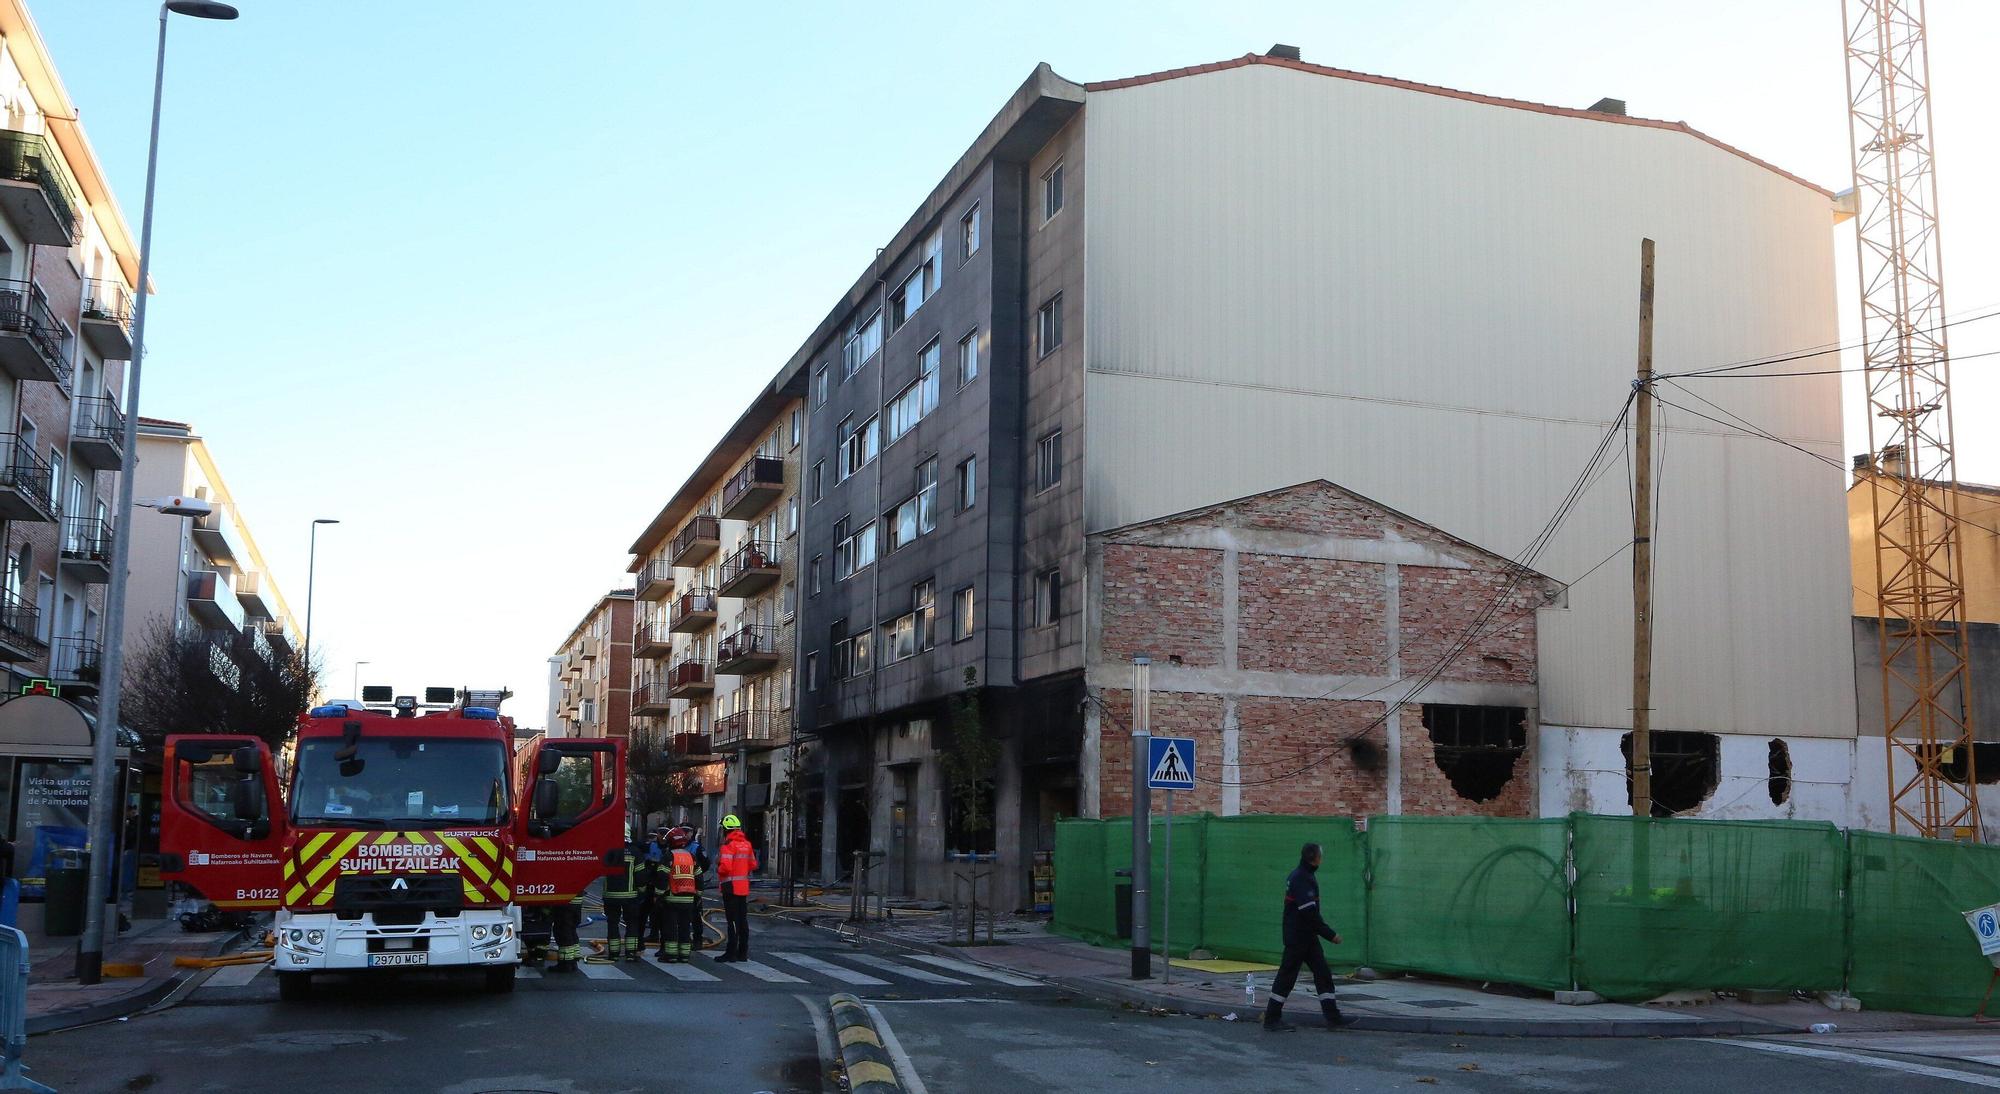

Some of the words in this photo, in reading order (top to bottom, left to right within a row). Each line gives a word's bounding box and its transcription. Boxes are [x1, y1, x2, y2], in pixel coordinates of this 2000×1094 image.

[28, 777, 55, 786] Visita
[72, 778, 91, 786] troc
[28, 787, 40, 796] de
[42, 787, 72, 796] Suecia
[74, 788, 88, 796] sin
[27, 797, 39, 805] de
[42, 797, 89, 807] Pamplona
[358, 844, 444, 857] BOMBEROS
[340, 857, 461, 871] SUHILTZAILEAK
[236, 889, 279, 899] B-0122
[516, 884, 555, 895] B-0122
[374, 955, 402, 965] 2970
[404, 954, 425, 964] MCF
